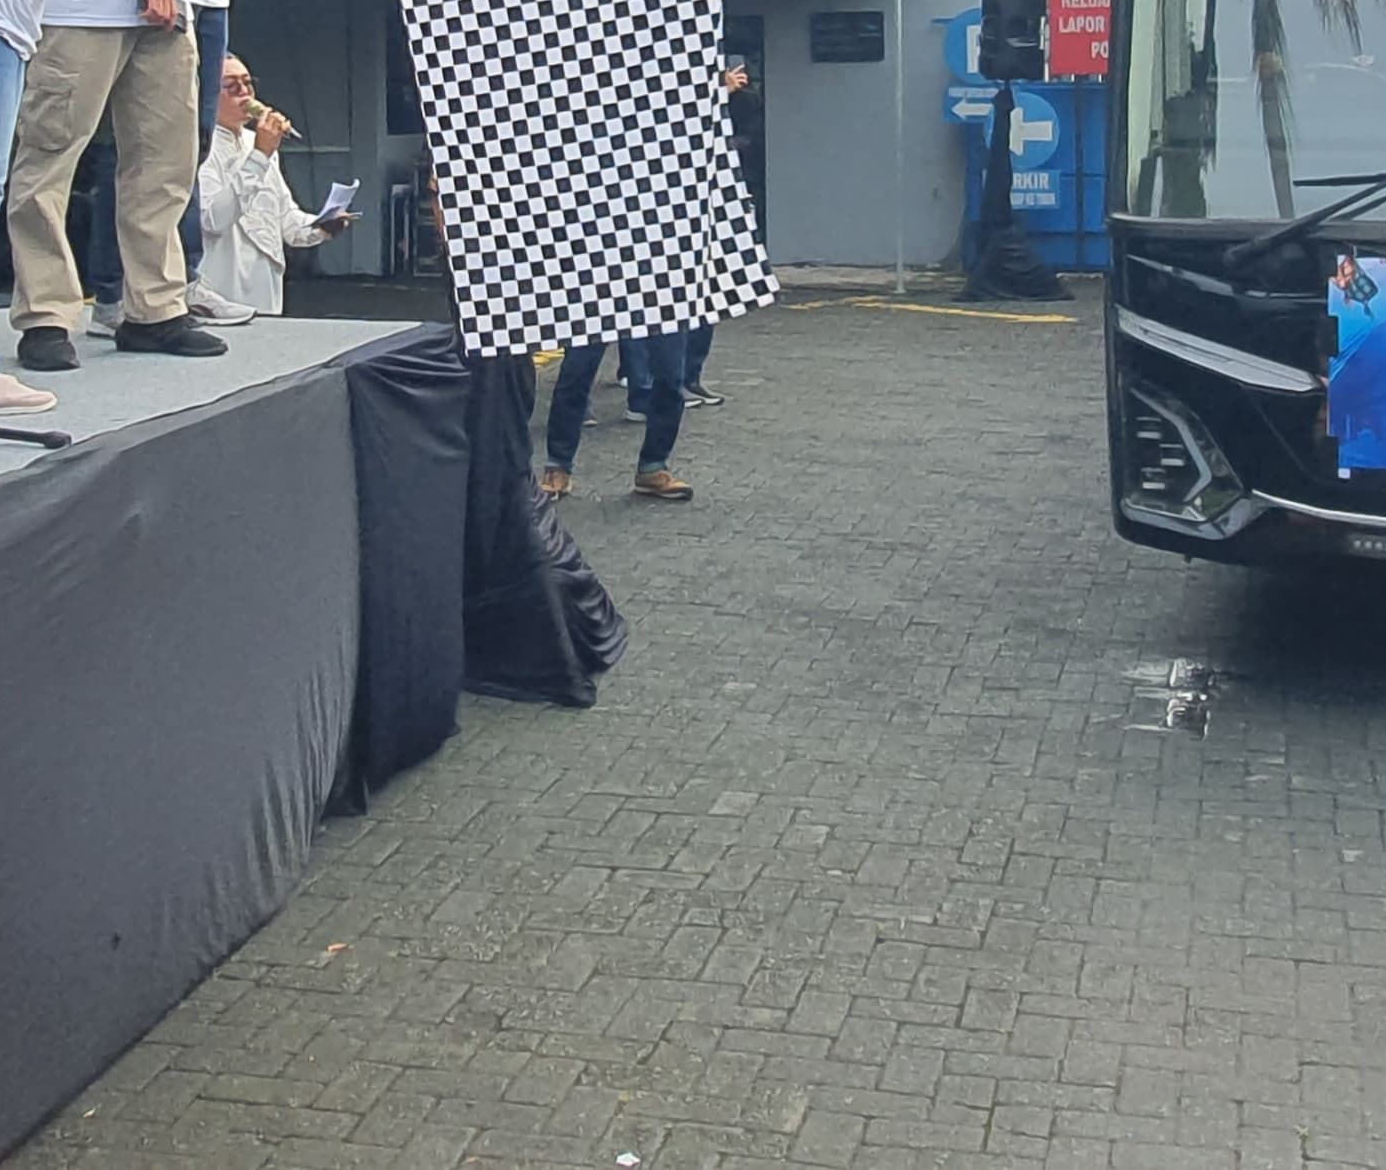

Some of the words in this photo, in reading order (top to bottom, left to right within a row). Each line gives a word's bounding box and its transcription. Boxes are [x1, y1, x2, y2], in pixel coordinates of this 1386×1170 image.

[1059, 15, 1105, 33] LAPOR
[1091, 40, 1109, 59] PO
[1012, 172, 1049, 190] RKIR
